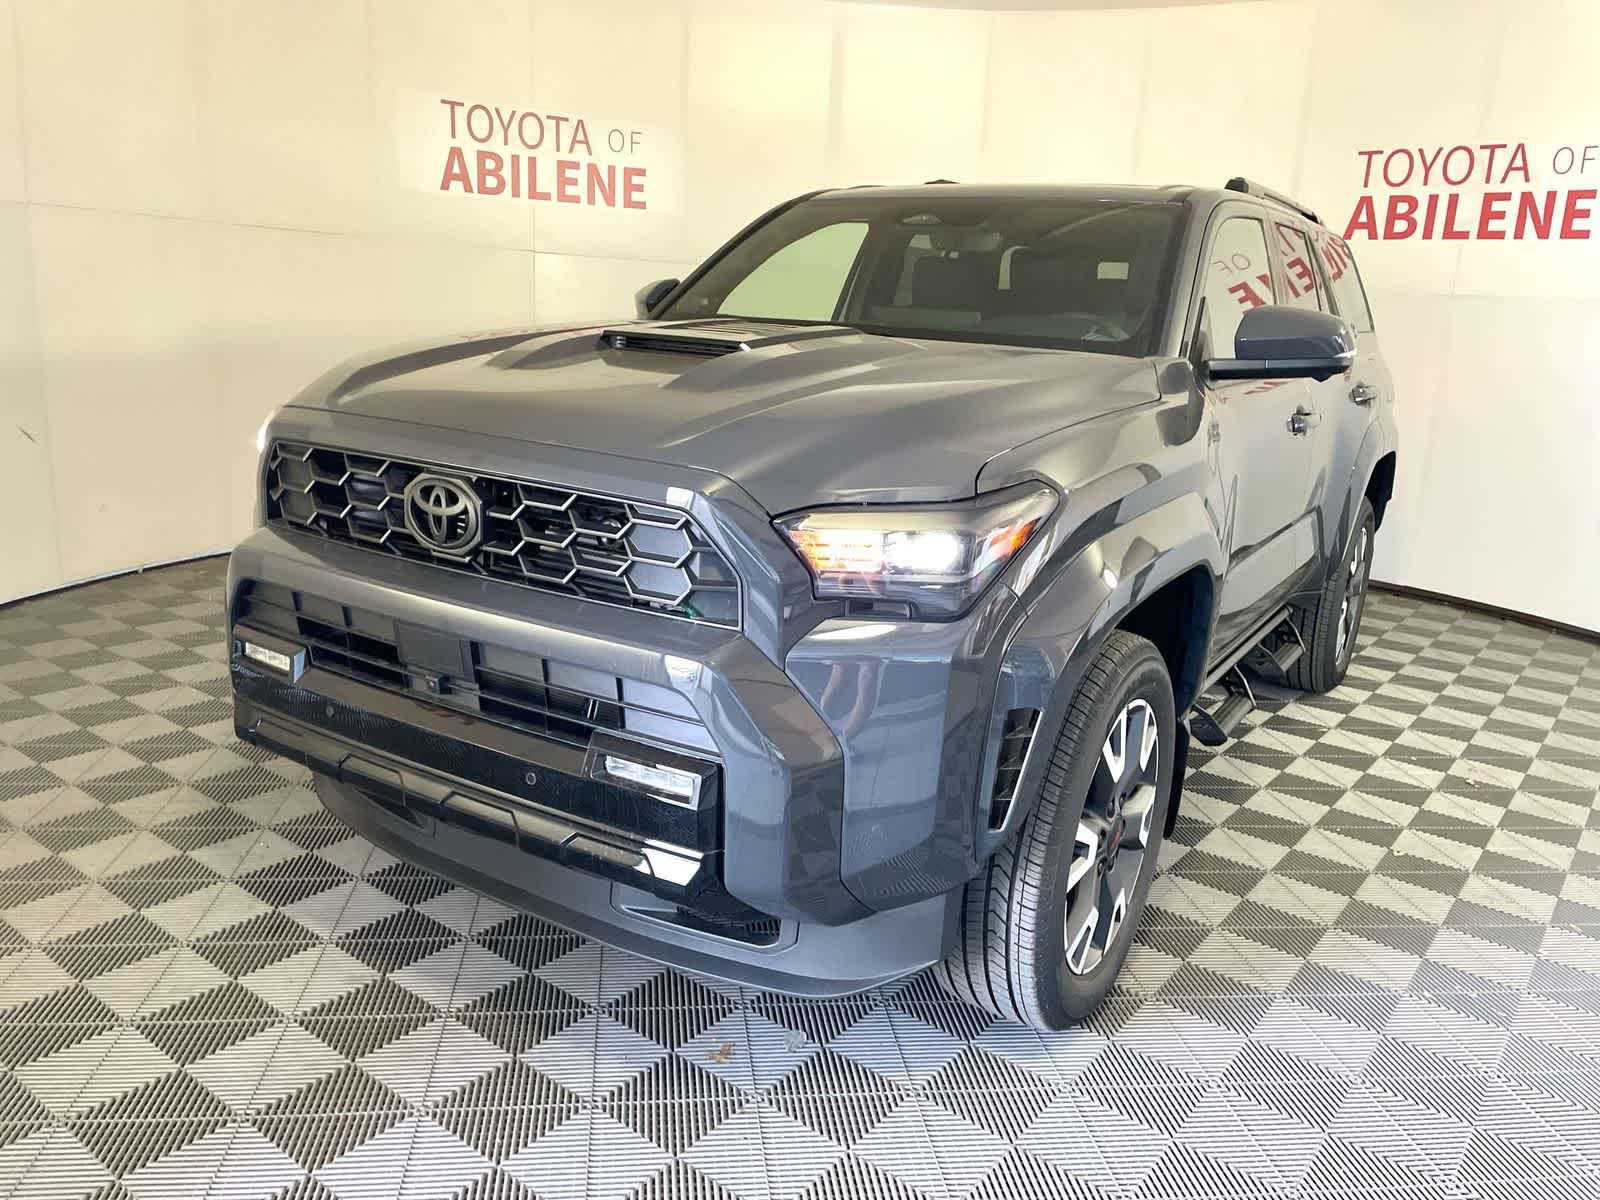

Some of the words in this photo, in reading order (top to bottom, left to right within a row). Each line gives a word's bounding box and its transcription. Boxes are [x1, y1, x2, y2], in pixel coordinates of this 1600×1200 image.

[440, 98, 593, 156] TOYOTA
[608, 128, 643, 154] OF
[440, 146, 648, 210] ABILENE
[1357, 142, 1531, 188] TOYOTA
[1552, 145, 1600, 175] OF
[1342, 189, 1598, 241] ABILENE
